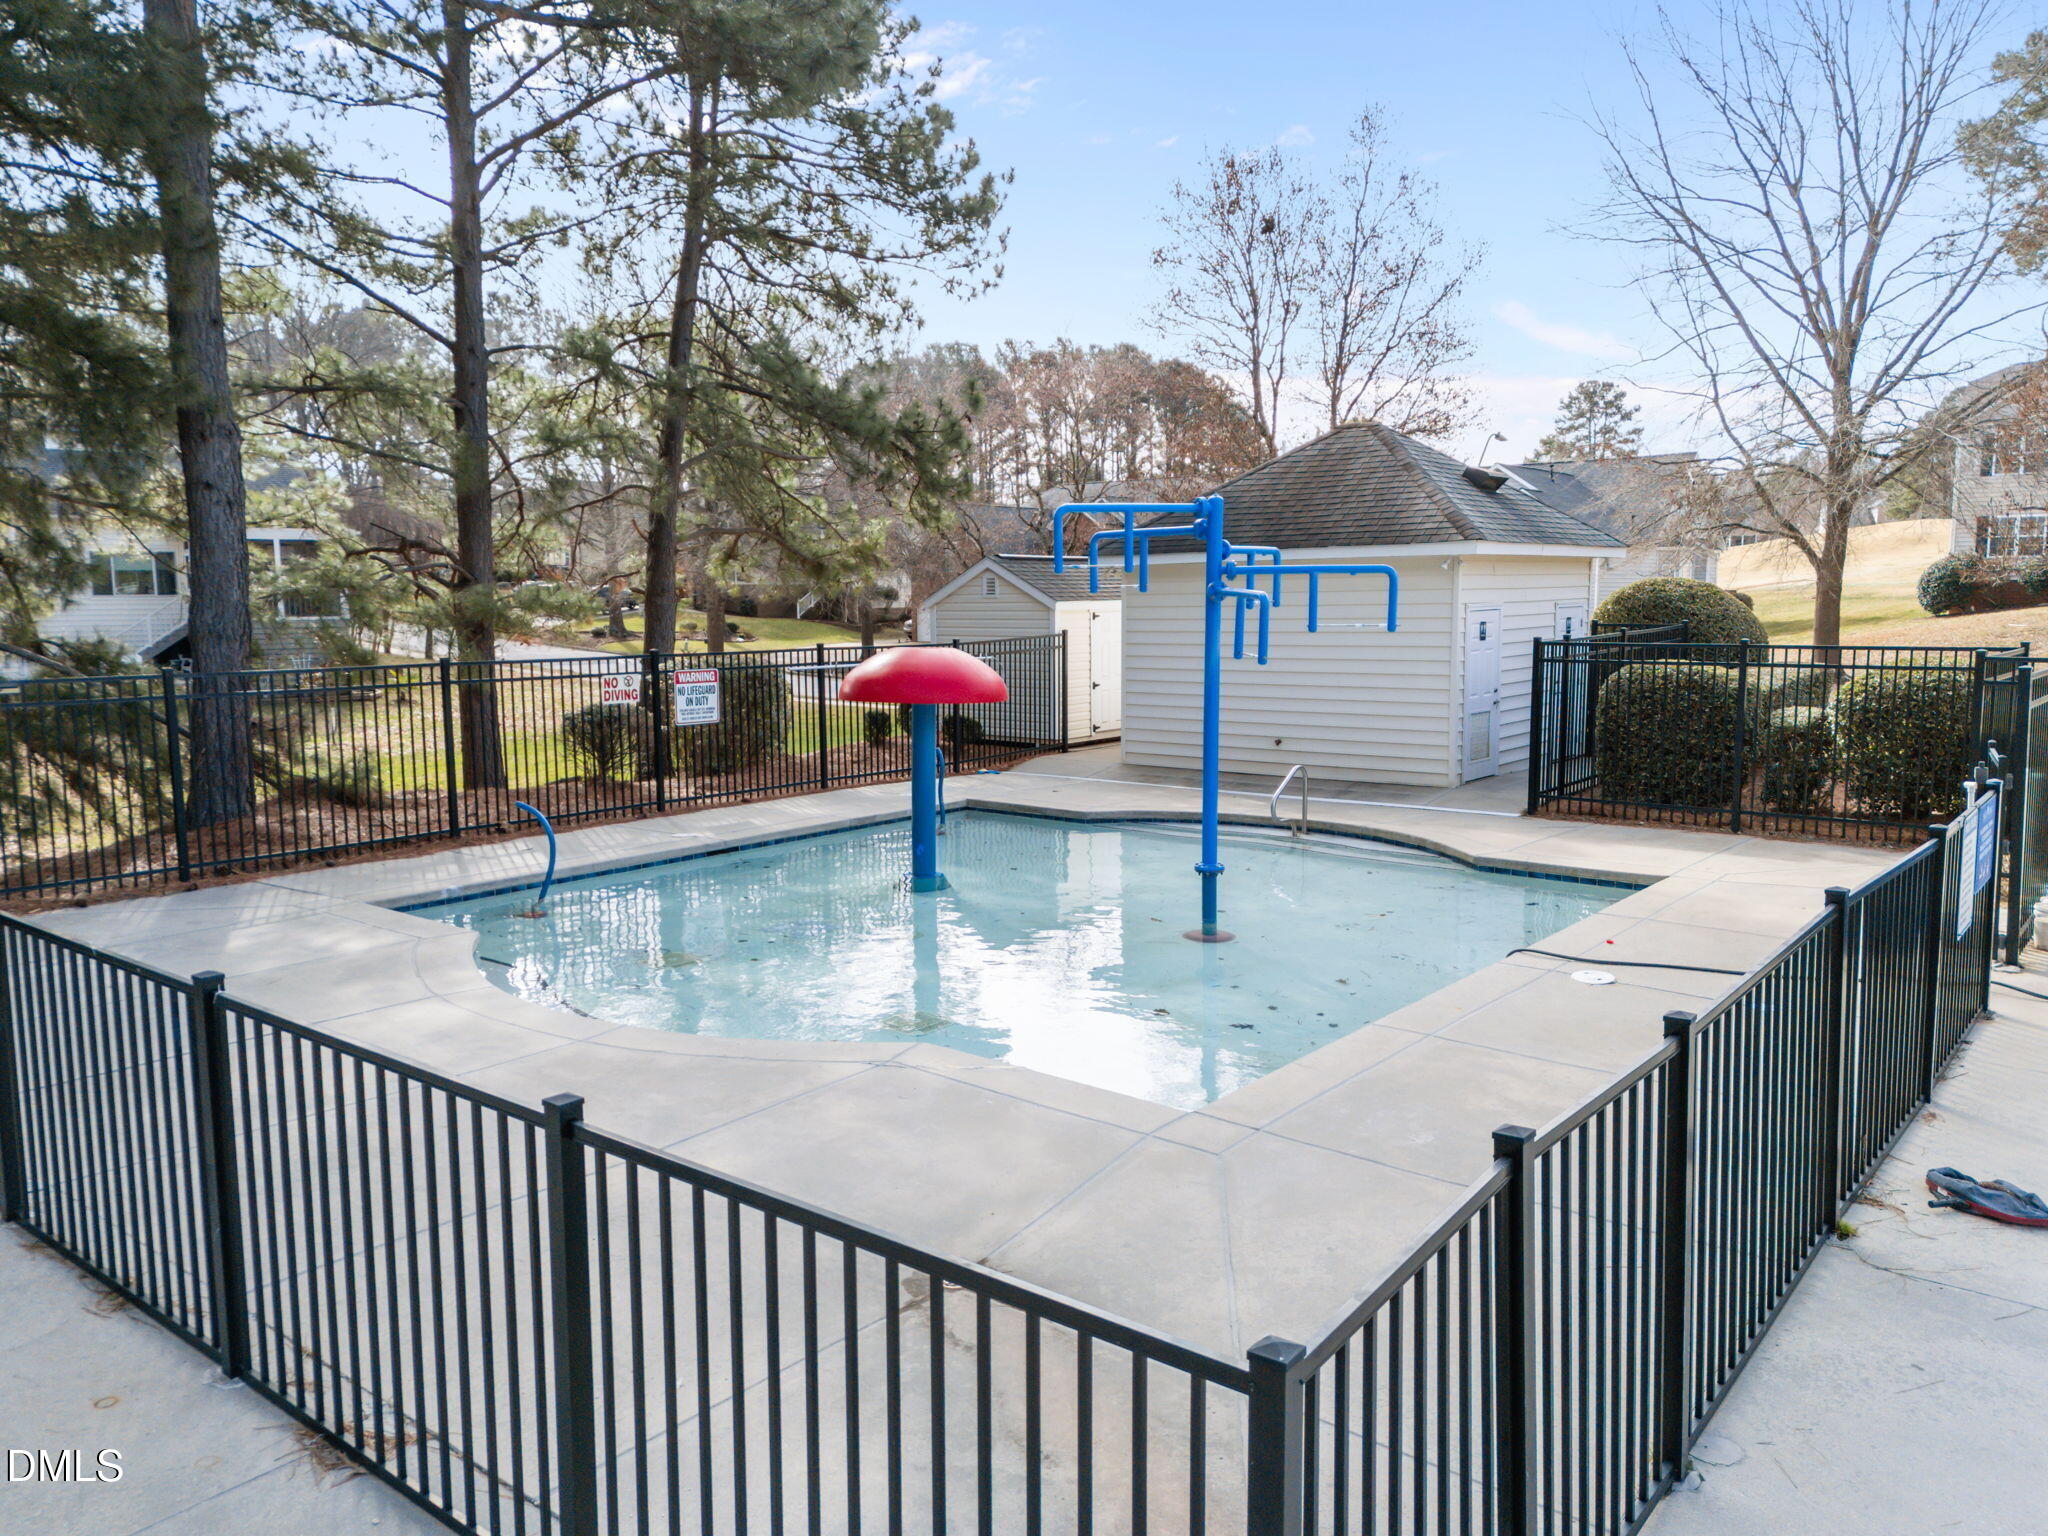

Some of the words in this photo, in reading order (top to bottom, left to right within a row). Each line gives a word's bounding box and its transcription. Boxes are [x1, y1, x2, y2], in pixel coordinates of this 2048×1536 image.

[604, 677, 619, 689] NO
[678, 671, 715, 683] WARNING
[604, 689, 638, 702] DIVING
[678, 686, 686, 696] NO
[687, 685, 716, 696] LIFEGUARD
[685, 697, 694, 707] ON
[695, 696, 709, 706] DUTY
